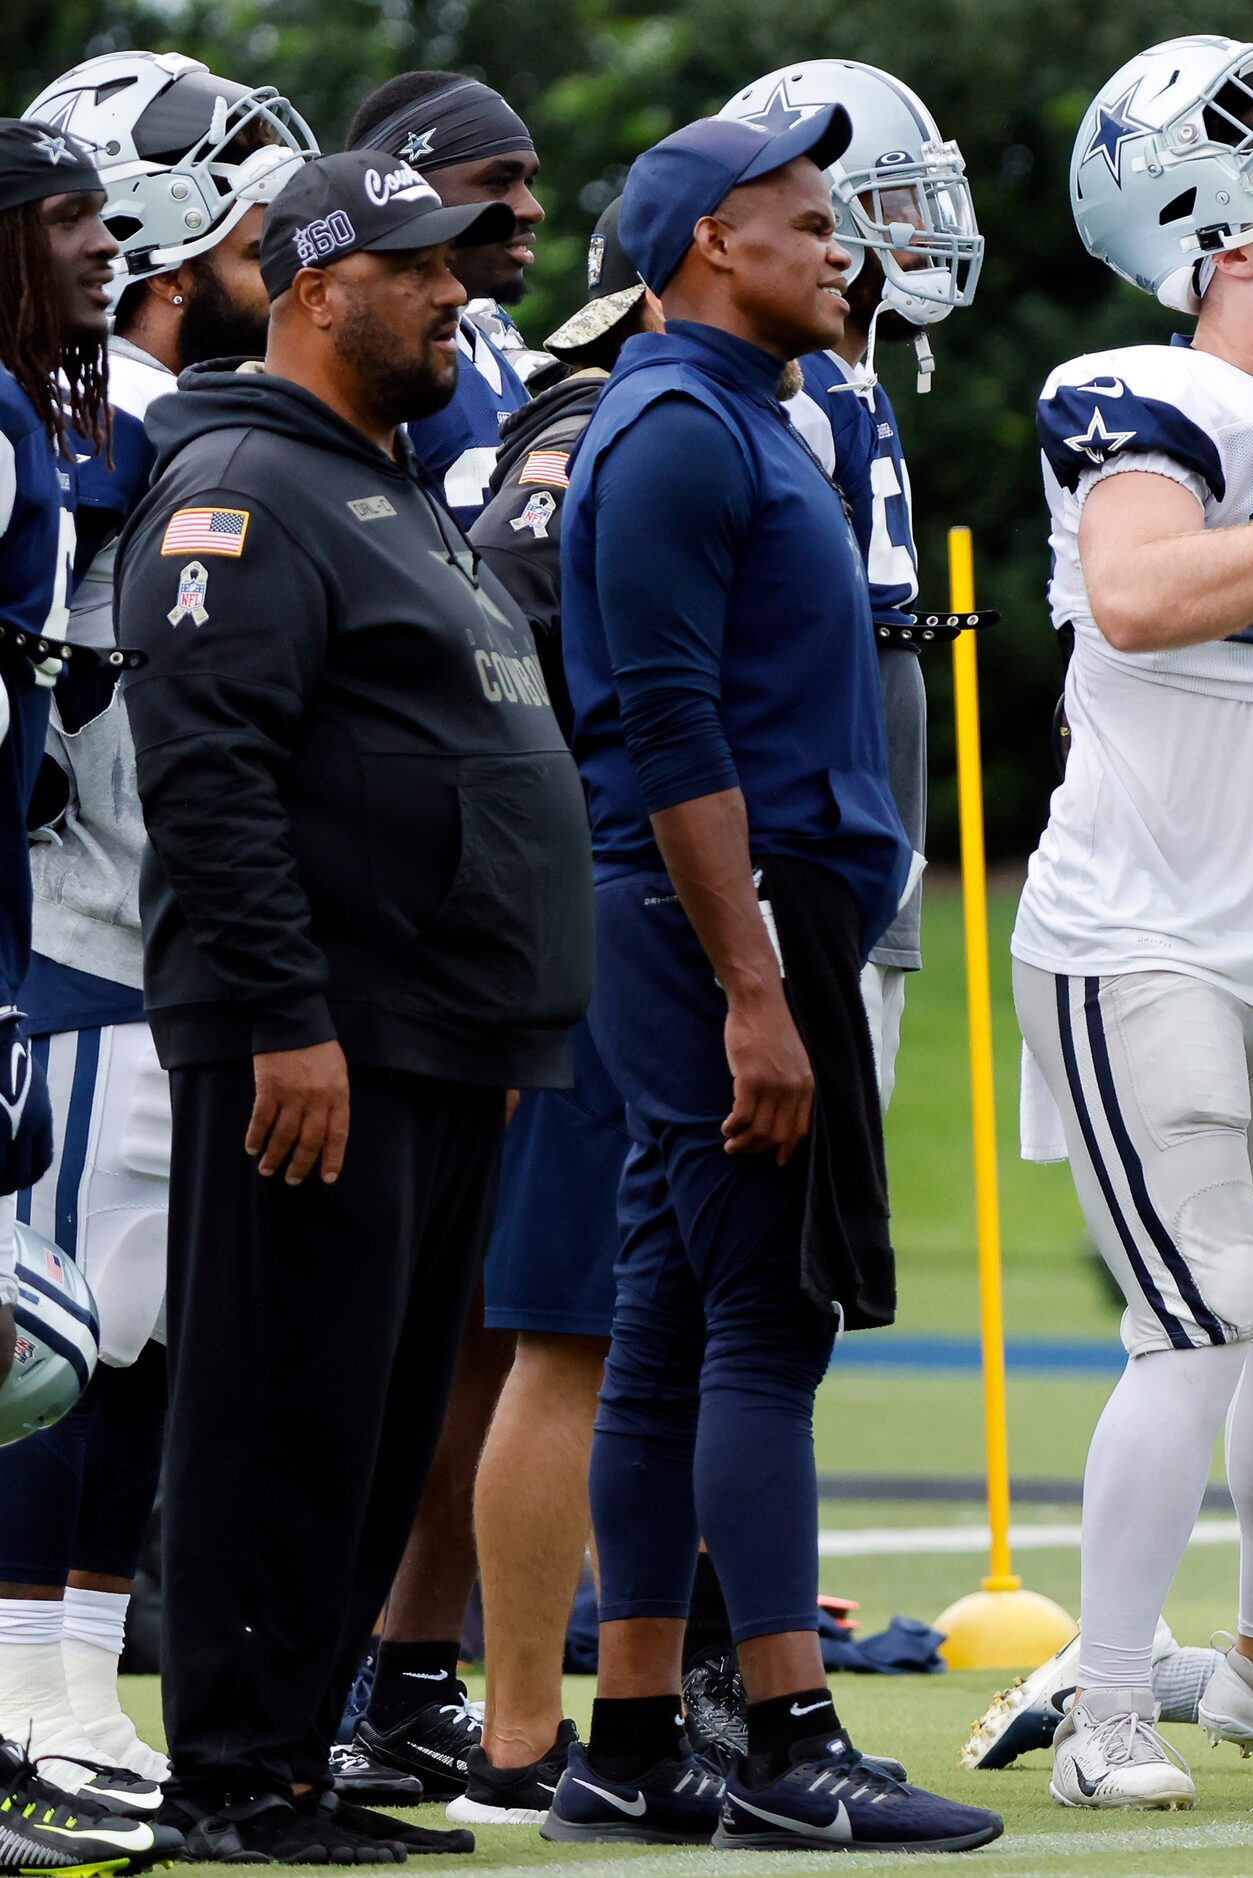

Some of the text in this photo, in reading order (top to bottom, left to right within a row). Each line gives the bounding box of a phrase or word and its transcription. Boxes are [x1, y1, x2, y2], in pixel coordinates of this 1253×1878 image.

[307, 209, 356, 256] 60
[525, 510, 546, 526] NFL
[181, 593, 202, 608] NFL
